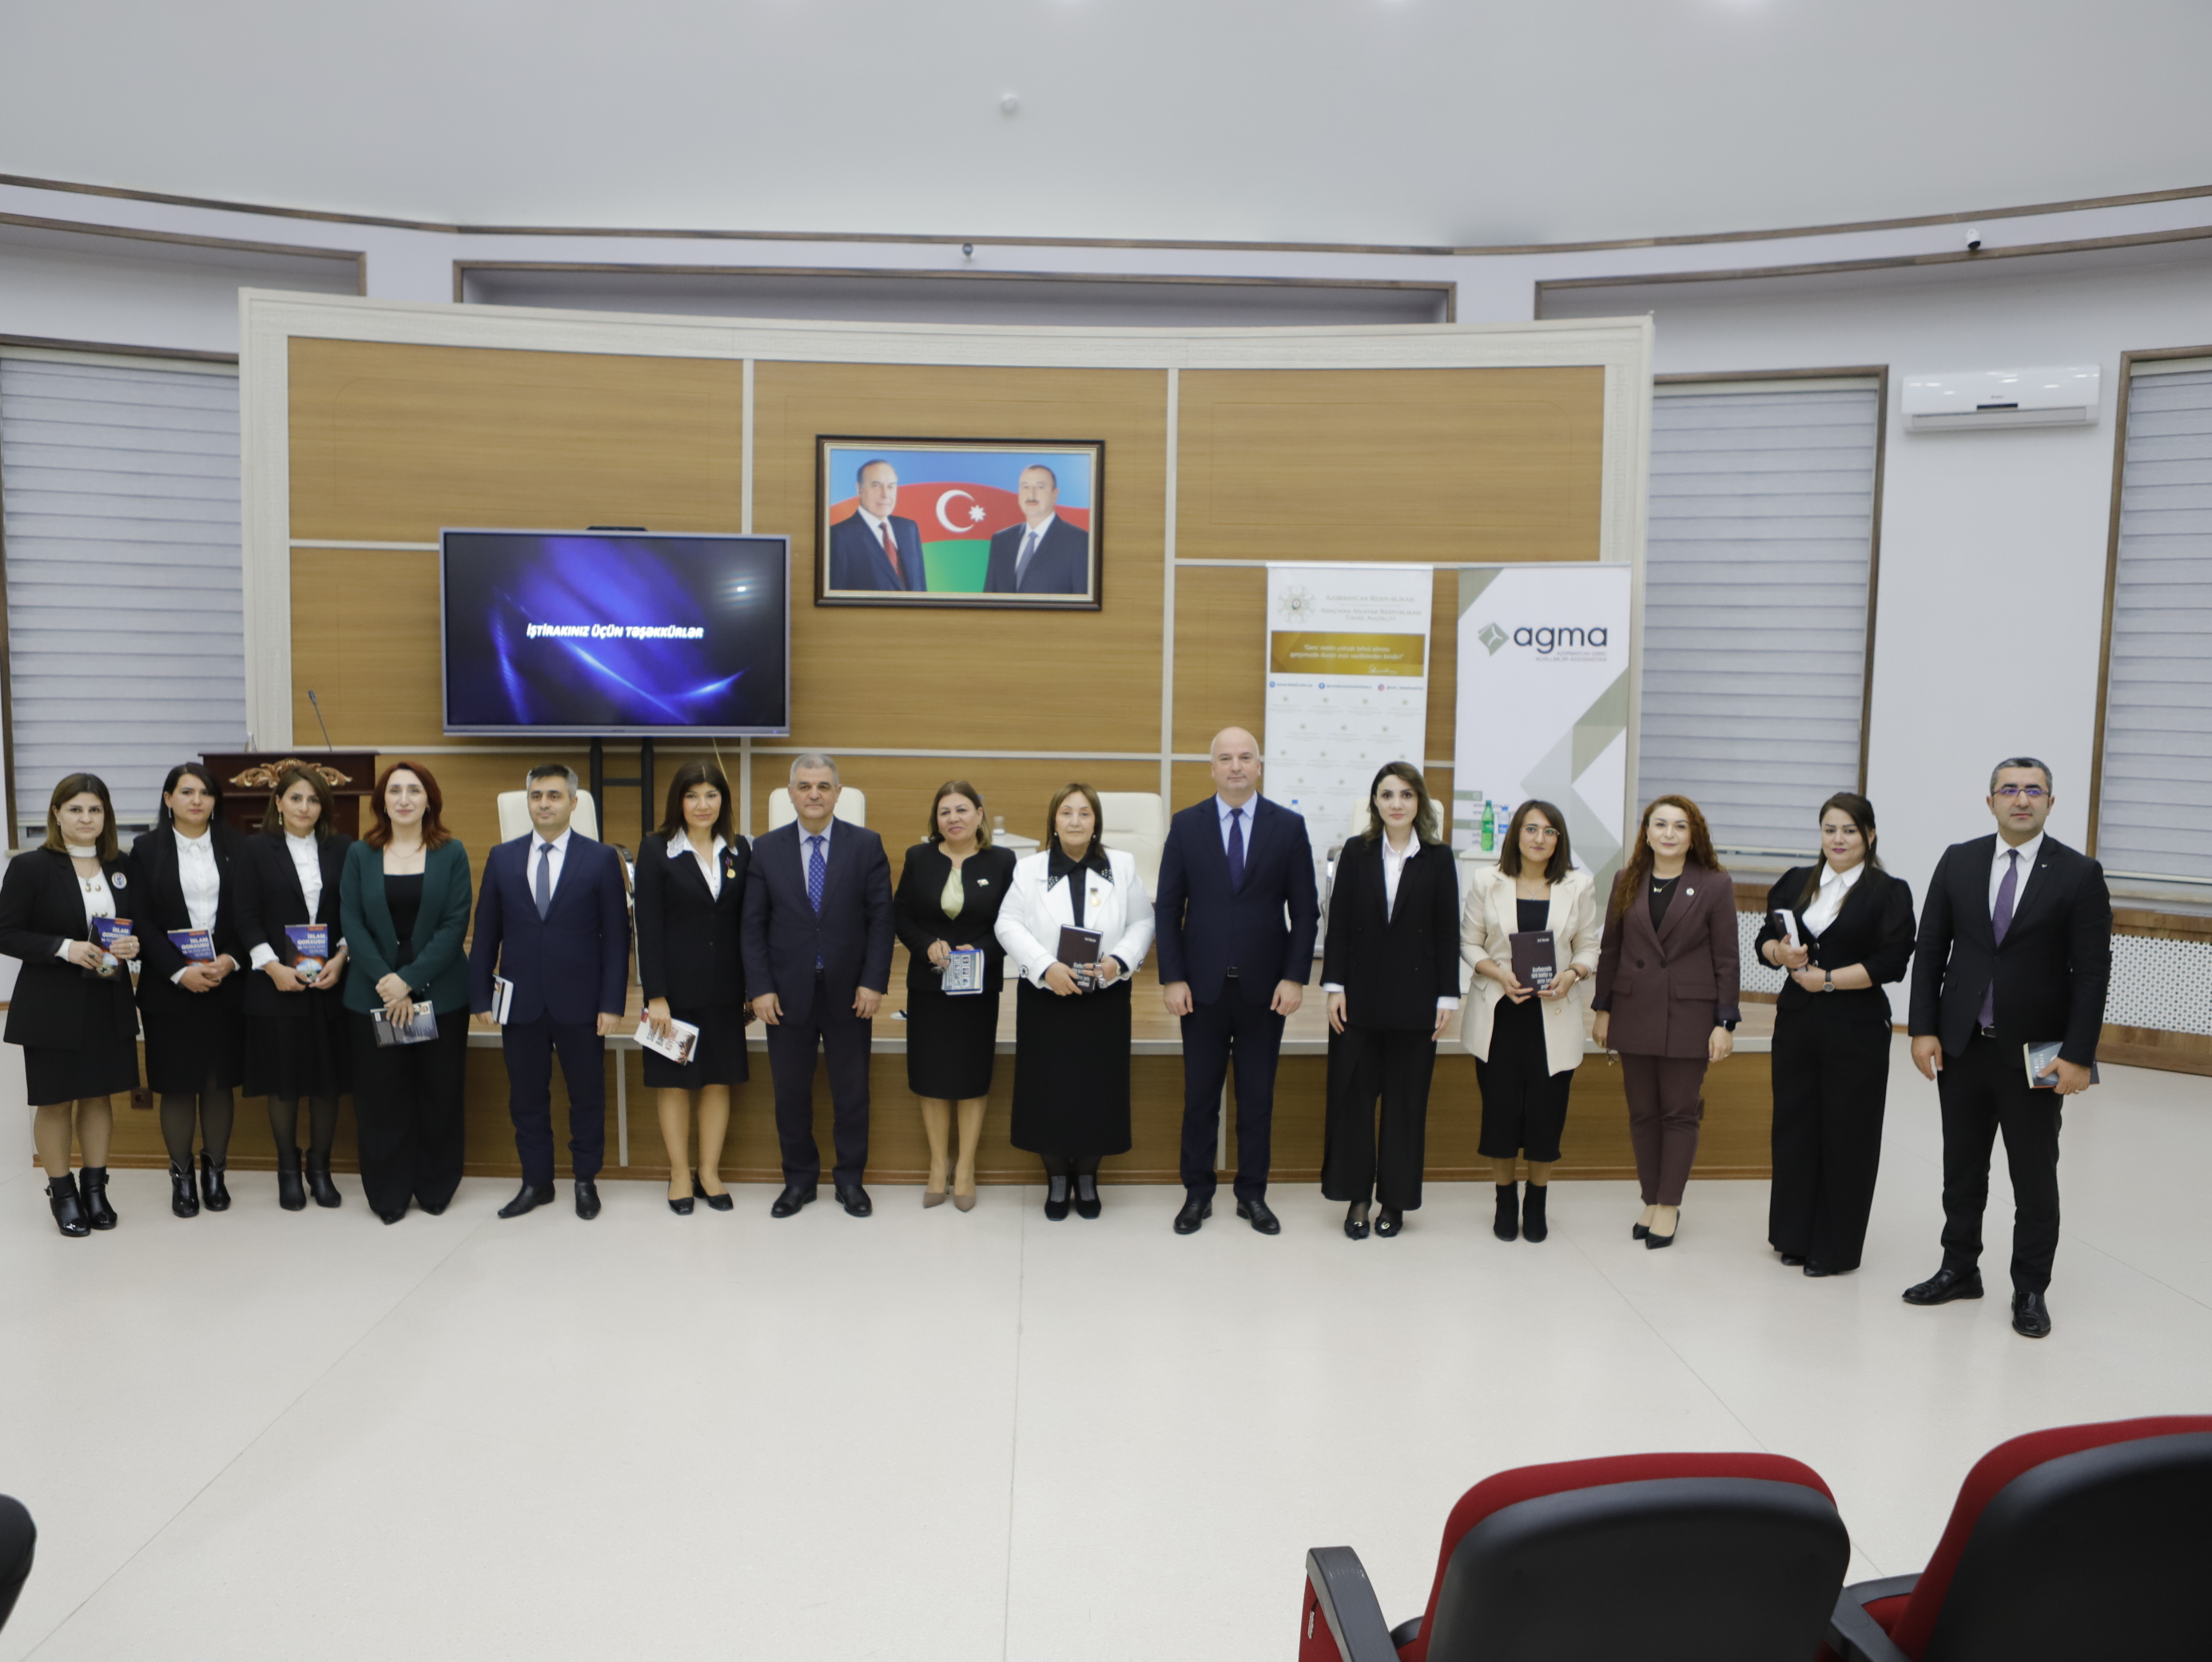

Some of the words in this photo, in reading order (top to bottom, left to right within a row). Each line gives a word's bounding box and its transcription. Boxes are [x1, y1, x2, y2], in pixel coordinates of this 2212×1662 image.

[526, 622, 590, 638] İŞTİRAKINIZ
[591, 624, 624, 639] ÜÇÜN
[625, 626, 704, 639] TƏŞƏKKÜRLƏR
[1514, 627, 1608, 654] agma
